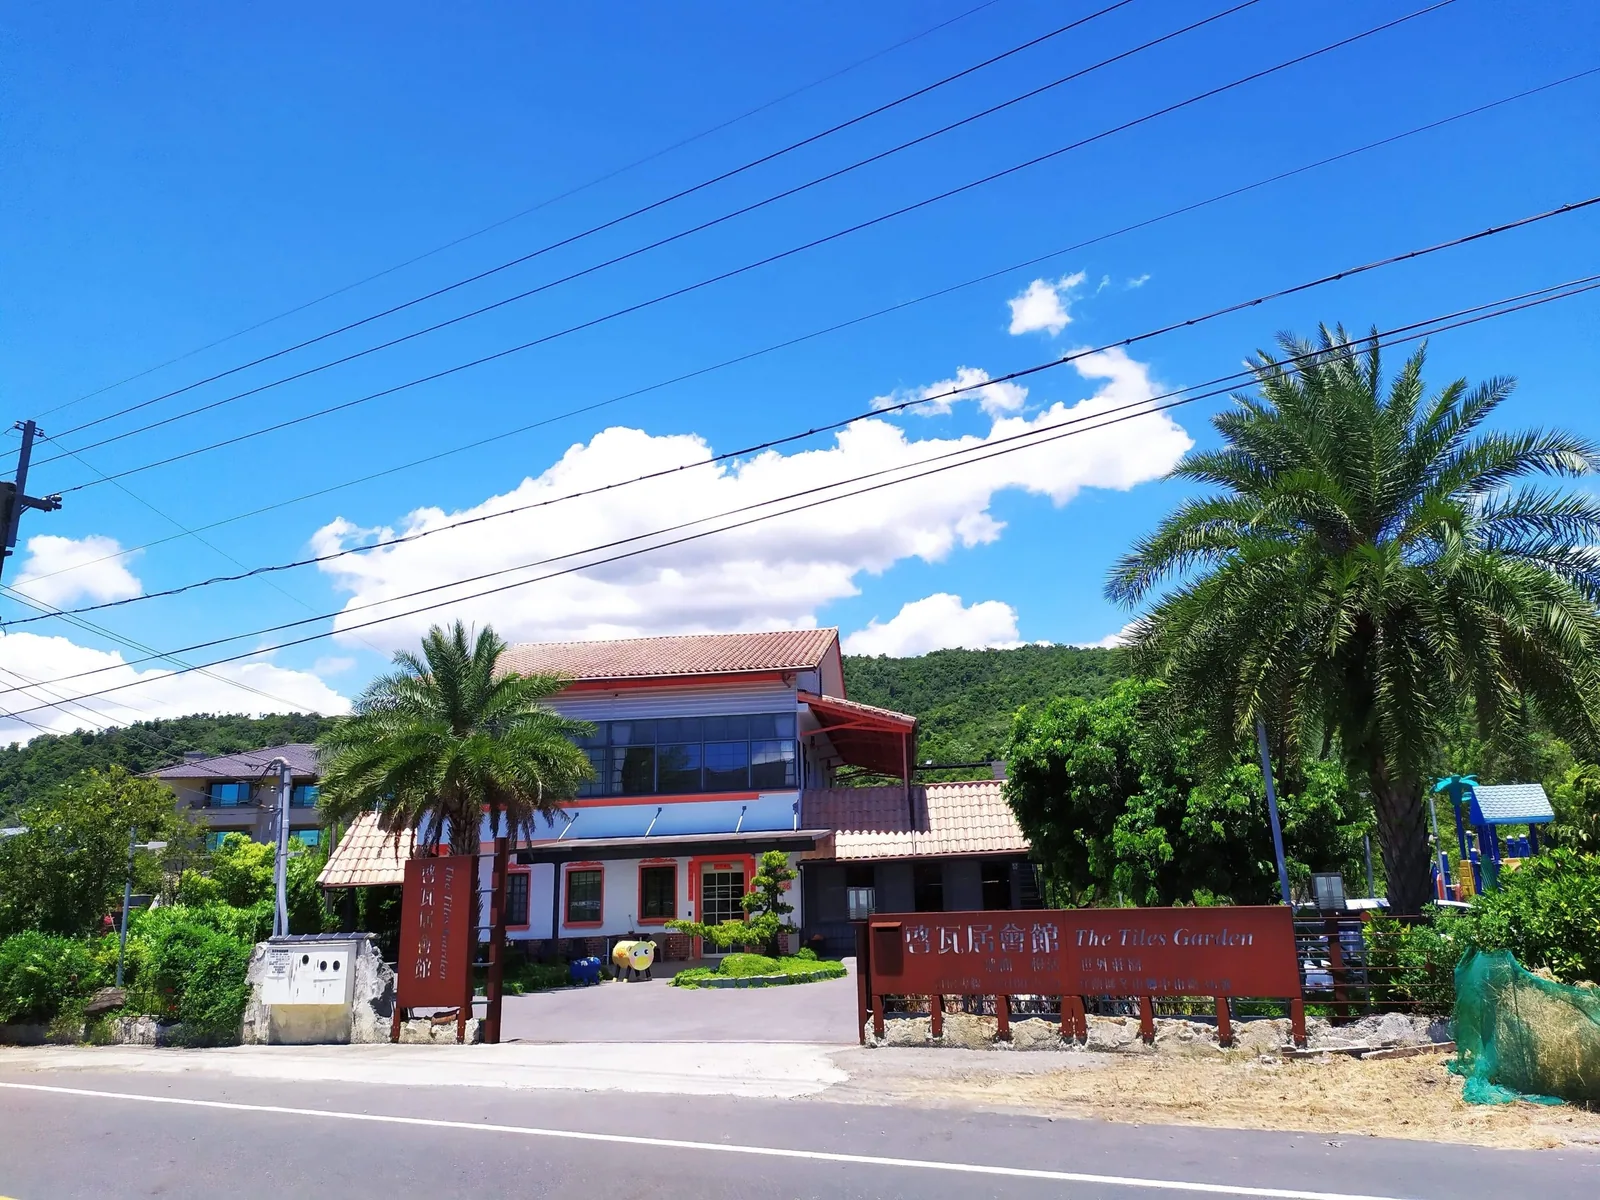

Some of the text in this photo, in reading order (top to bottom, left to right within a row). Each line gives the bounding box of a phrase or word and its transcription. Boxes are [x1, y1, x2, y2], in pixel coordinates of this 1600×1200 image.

[444, 866, 454, 890] The
[443, 895, 453, 924] Tiles
[1076, 928, 1254, 946] The Tiles Garden
